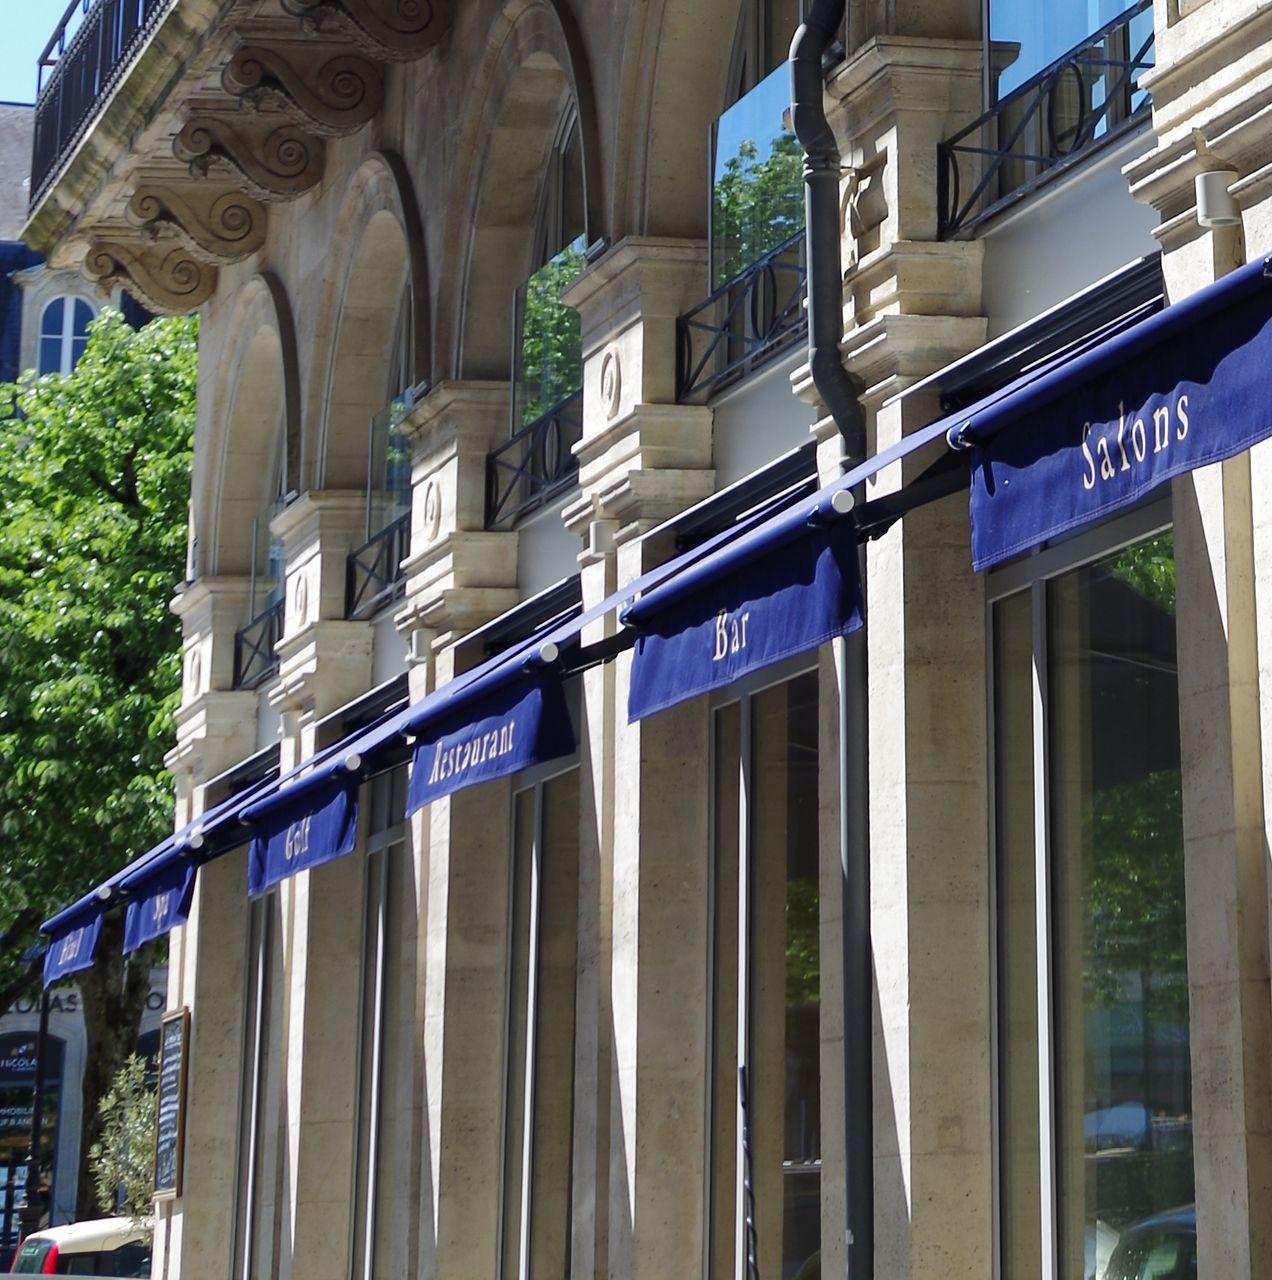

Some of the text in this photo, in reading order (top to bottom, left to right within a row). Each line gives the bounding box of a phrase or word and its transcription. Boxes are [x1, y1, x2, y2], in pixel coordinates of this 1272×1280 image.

[1082, 393, 1190, 490] Salons
[712, 607, 750, 662] Bar
[428, 719, 515, 785] Restaurant
[285, 810, 313, 860] Golf
